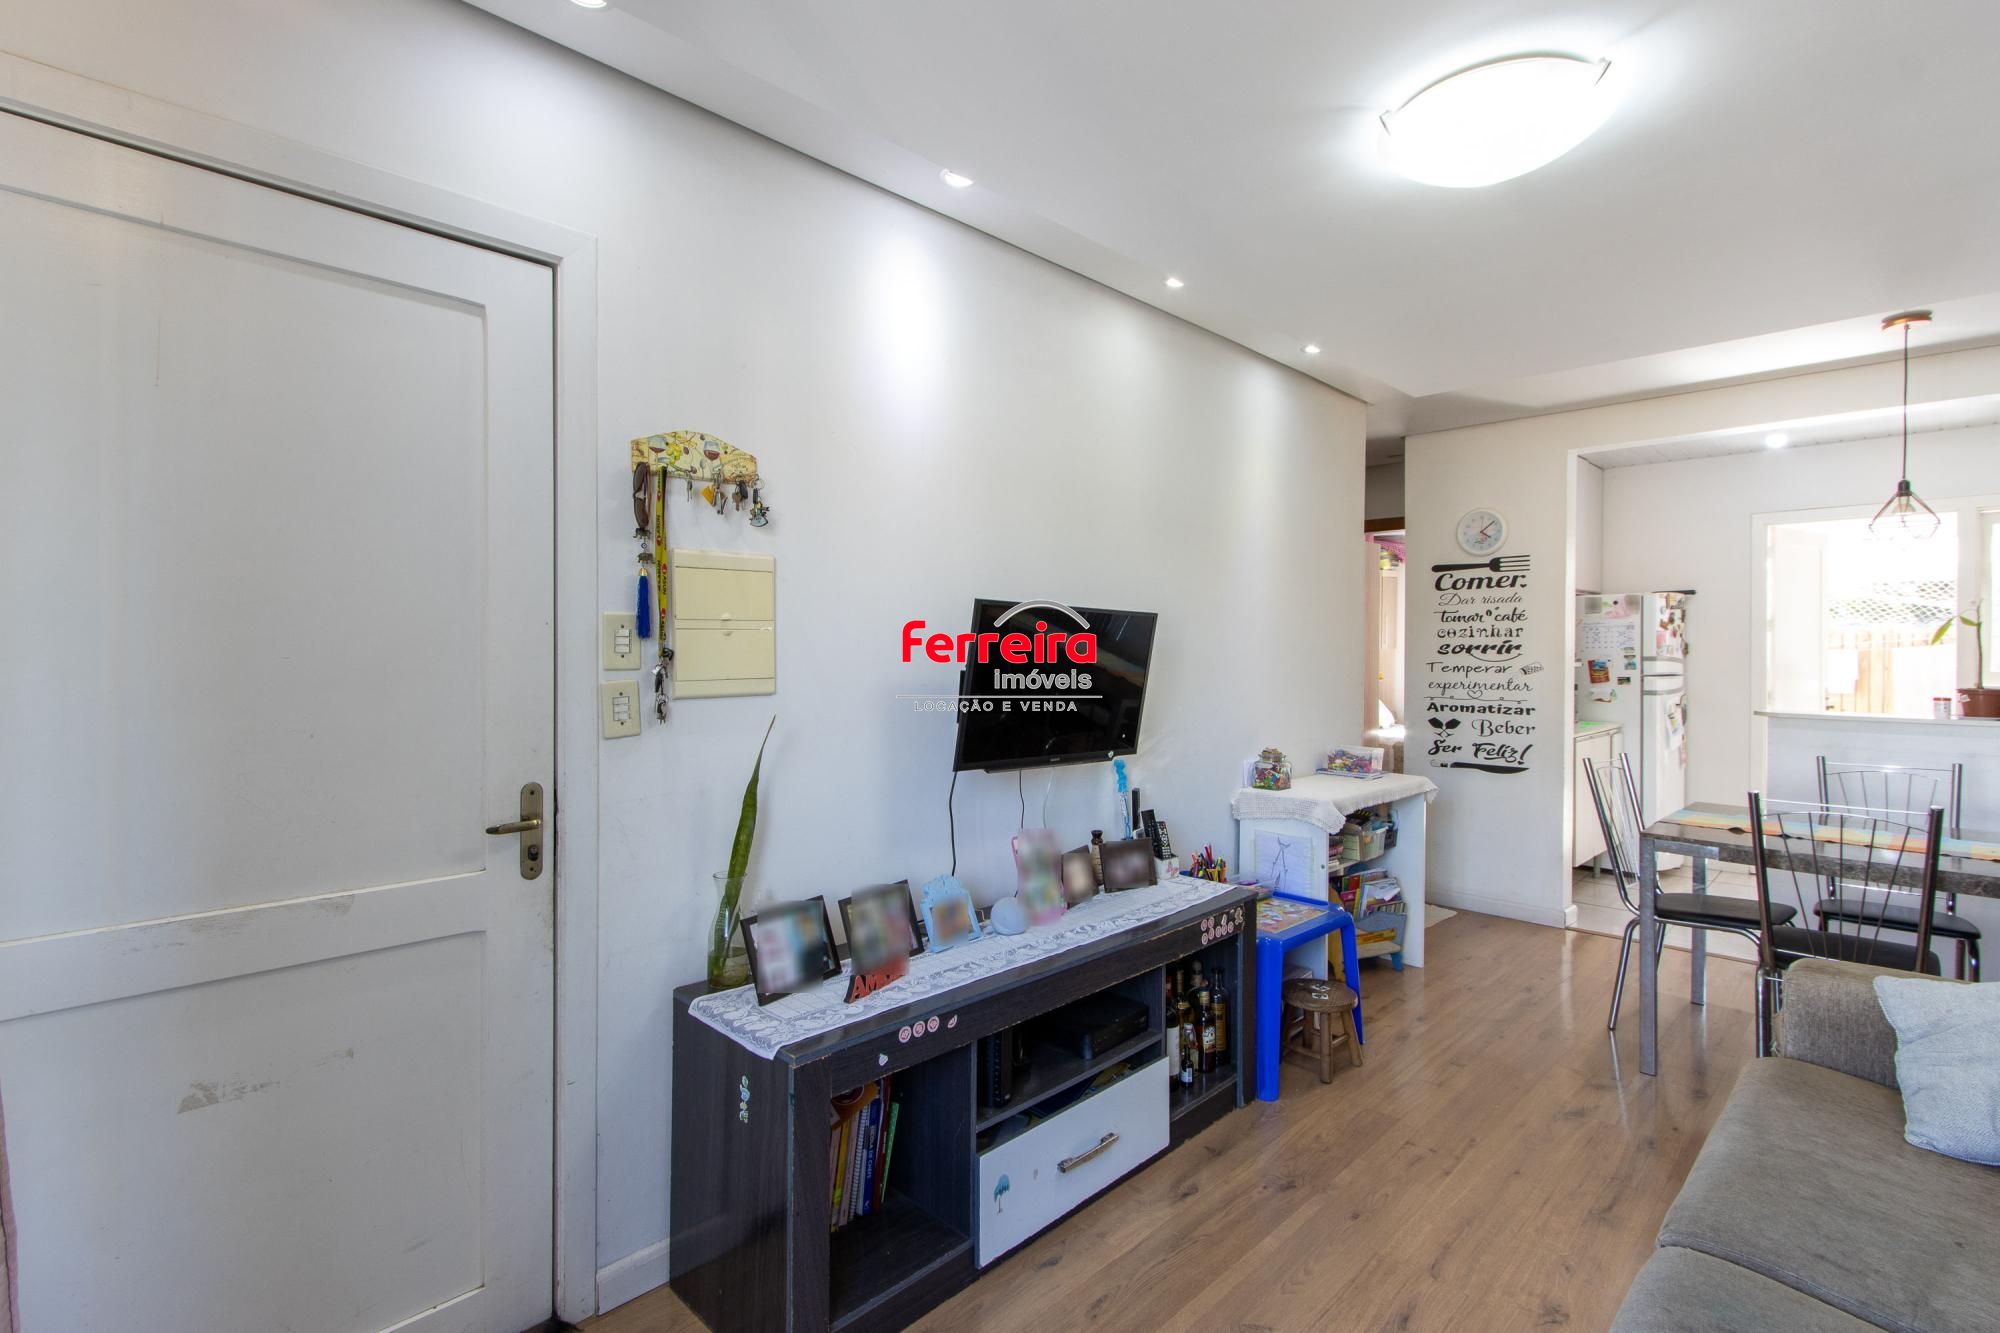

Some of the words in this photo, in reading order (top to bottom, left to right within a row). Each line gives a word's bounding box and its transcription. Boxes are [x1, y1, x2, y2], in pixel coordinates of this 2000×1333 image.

[1434, 573, 1527, 591] Comer
[1438, 592, 1475, 606] Dar
[1482, 592, 1522, 604] risada
[1494, 607, 1528, 622] café
[1437, 625, 1524, 638] cozinhar
[1437, 640, 1523, 655] sorrir
[1426, 662, 1512, 678] Temperar
[1428, 678, 1534, 696] experimentar
[1426, 702, 1536, 716] Aromatizar
[1471, 719, 1536, 737] Beber
[1428, 739, 1462, 755] Ser
